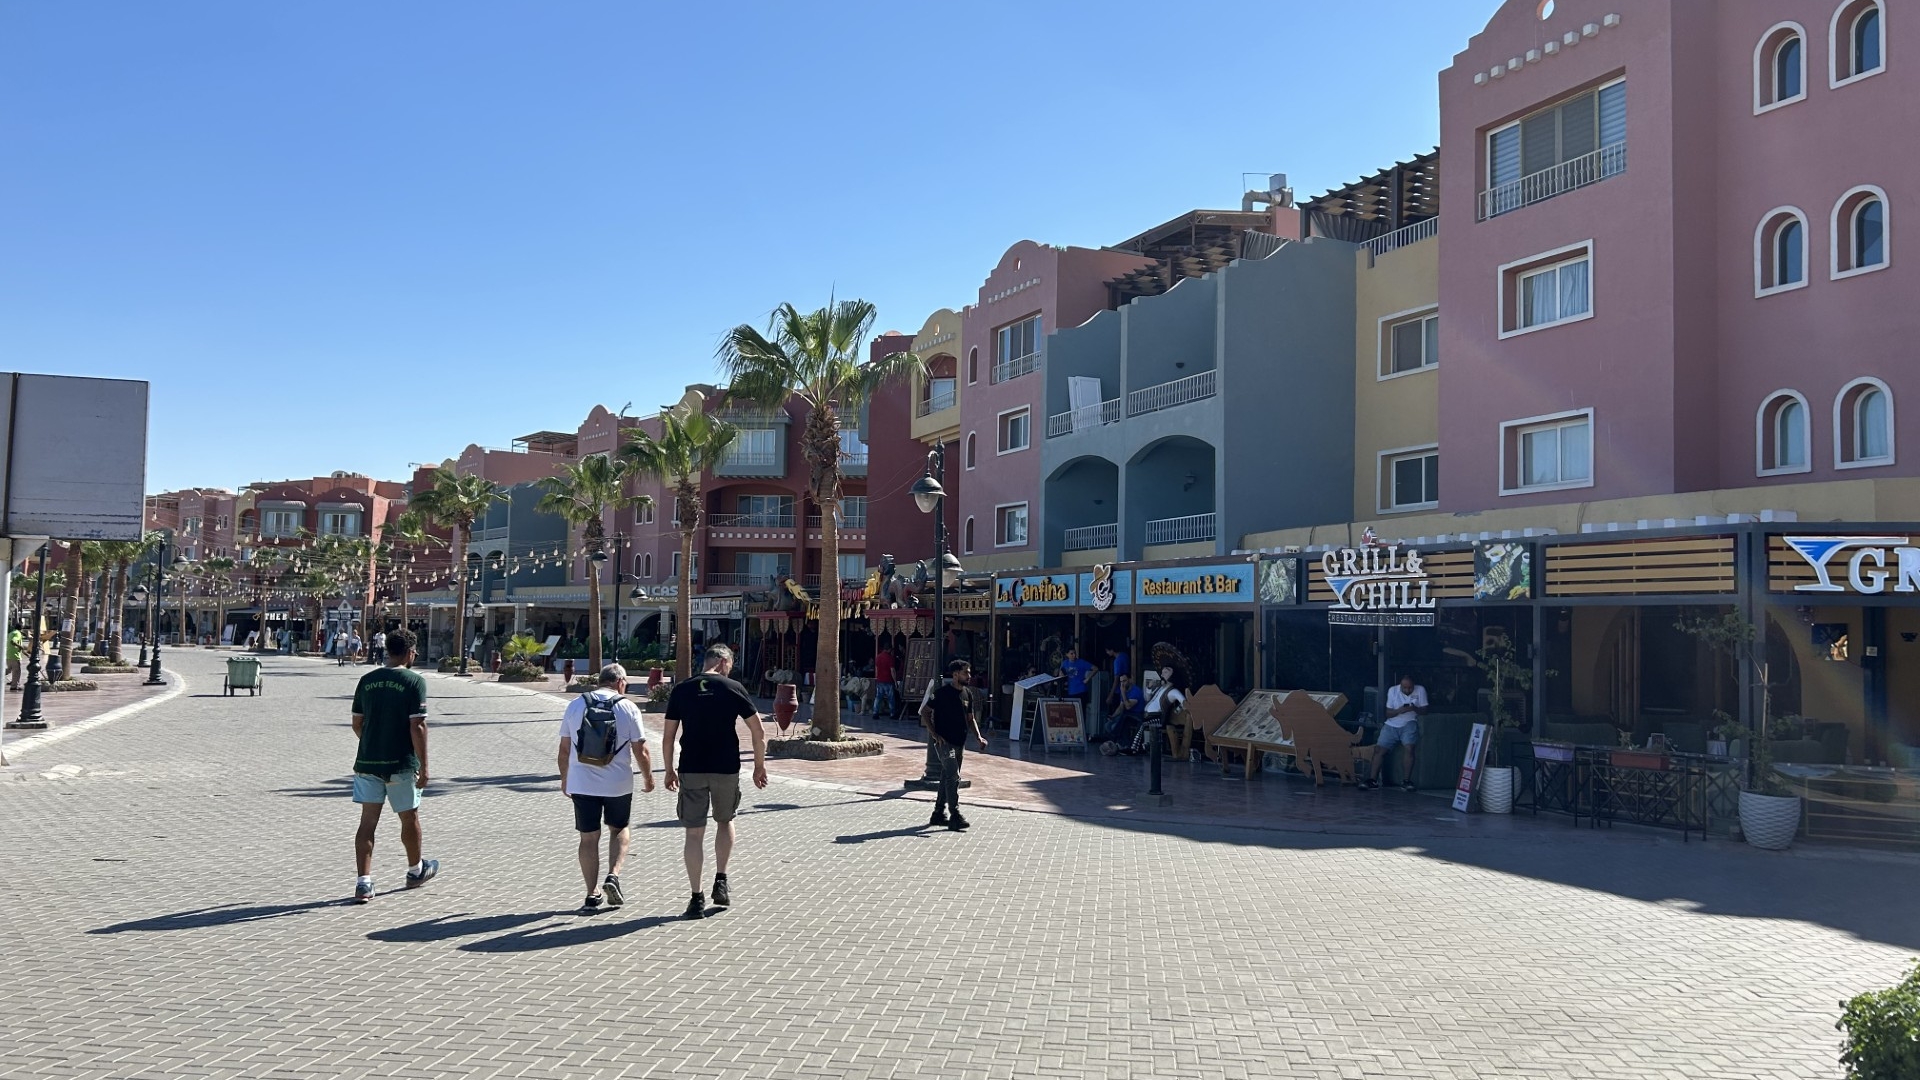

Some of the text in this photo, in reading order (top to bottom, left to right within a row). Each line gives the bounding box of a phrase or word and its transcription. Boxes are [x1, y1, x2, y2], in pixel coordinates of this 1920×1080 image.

[996, 583, 1008, 602] La
[1009, 577, 1067, 607] Cantina
[1143, 574, 1239, 596] Restaurant & Bar
[1350, 581, 1435, 610] CHILL
[265, 613, 281, 621] THE
[1331, 614, 1376, 623] RESTAURANT
[1386, 615, 1412, 623] SHISHA
[1417, 615, 1431, 623] BAR
[364, 680, 405, 692] DIVE TEAM
